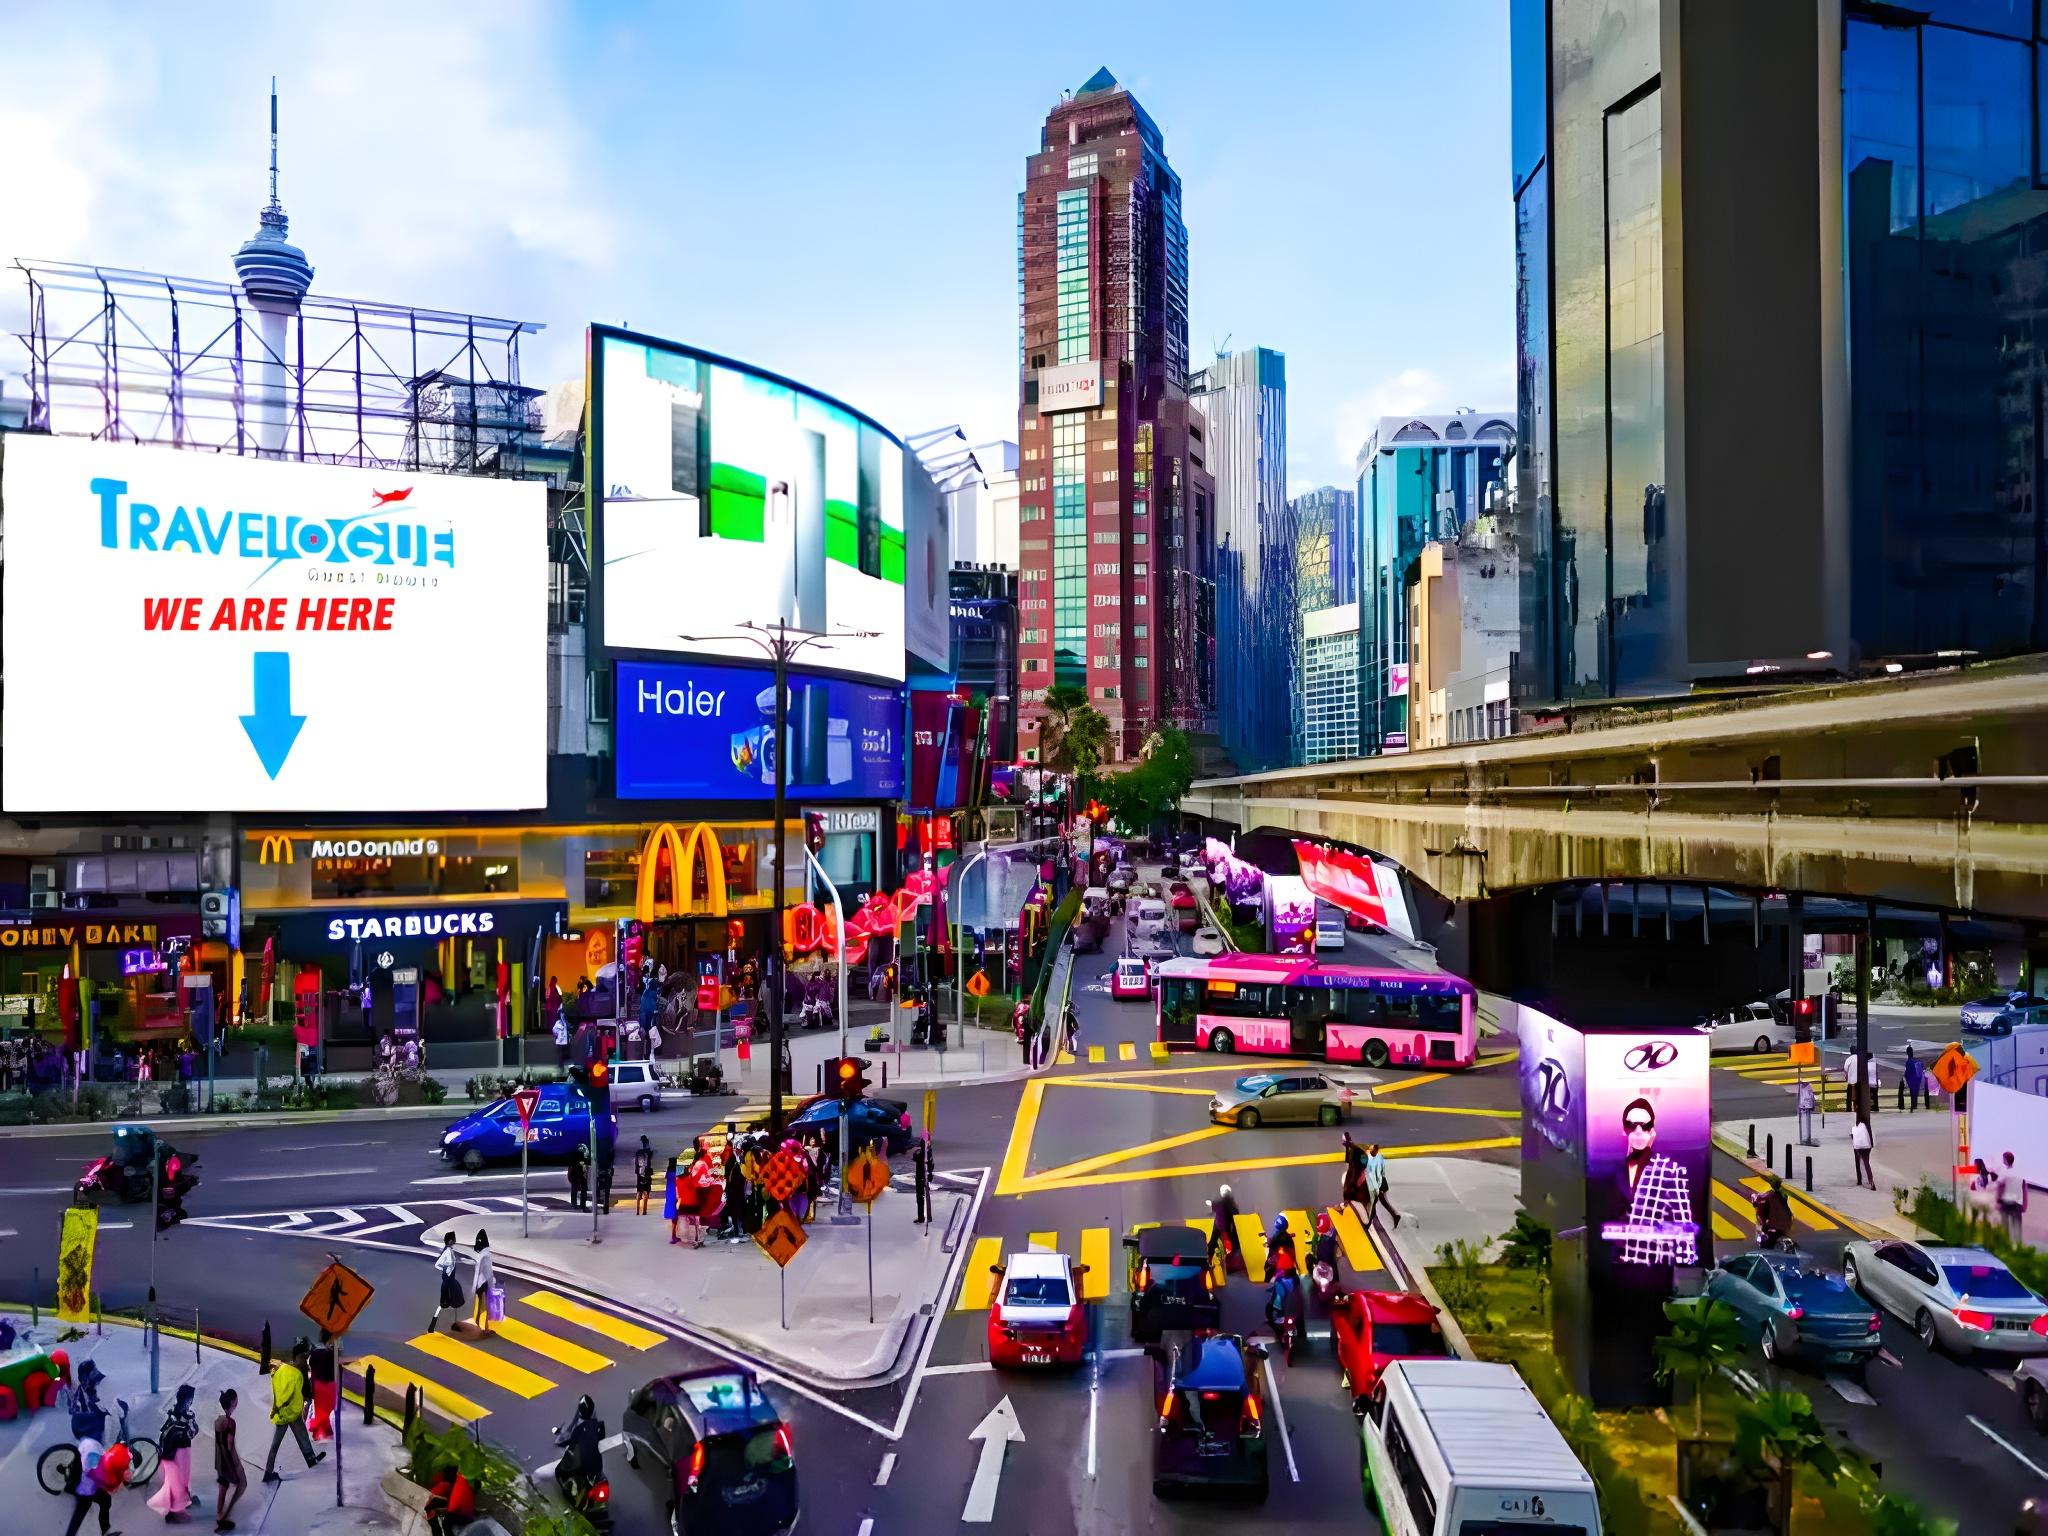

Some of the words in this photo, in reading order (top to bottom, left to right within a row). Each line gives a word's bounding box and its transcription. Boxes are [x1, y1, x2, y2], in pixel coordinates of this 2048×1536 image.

[143, 598, 202, 631] WE
[208, 598, 288, 631] ARE
[295, 598, 395, 631] HERE
[638, 679, 726, 717] Haier
[328, 912, 494, 940] STARBUCKS
